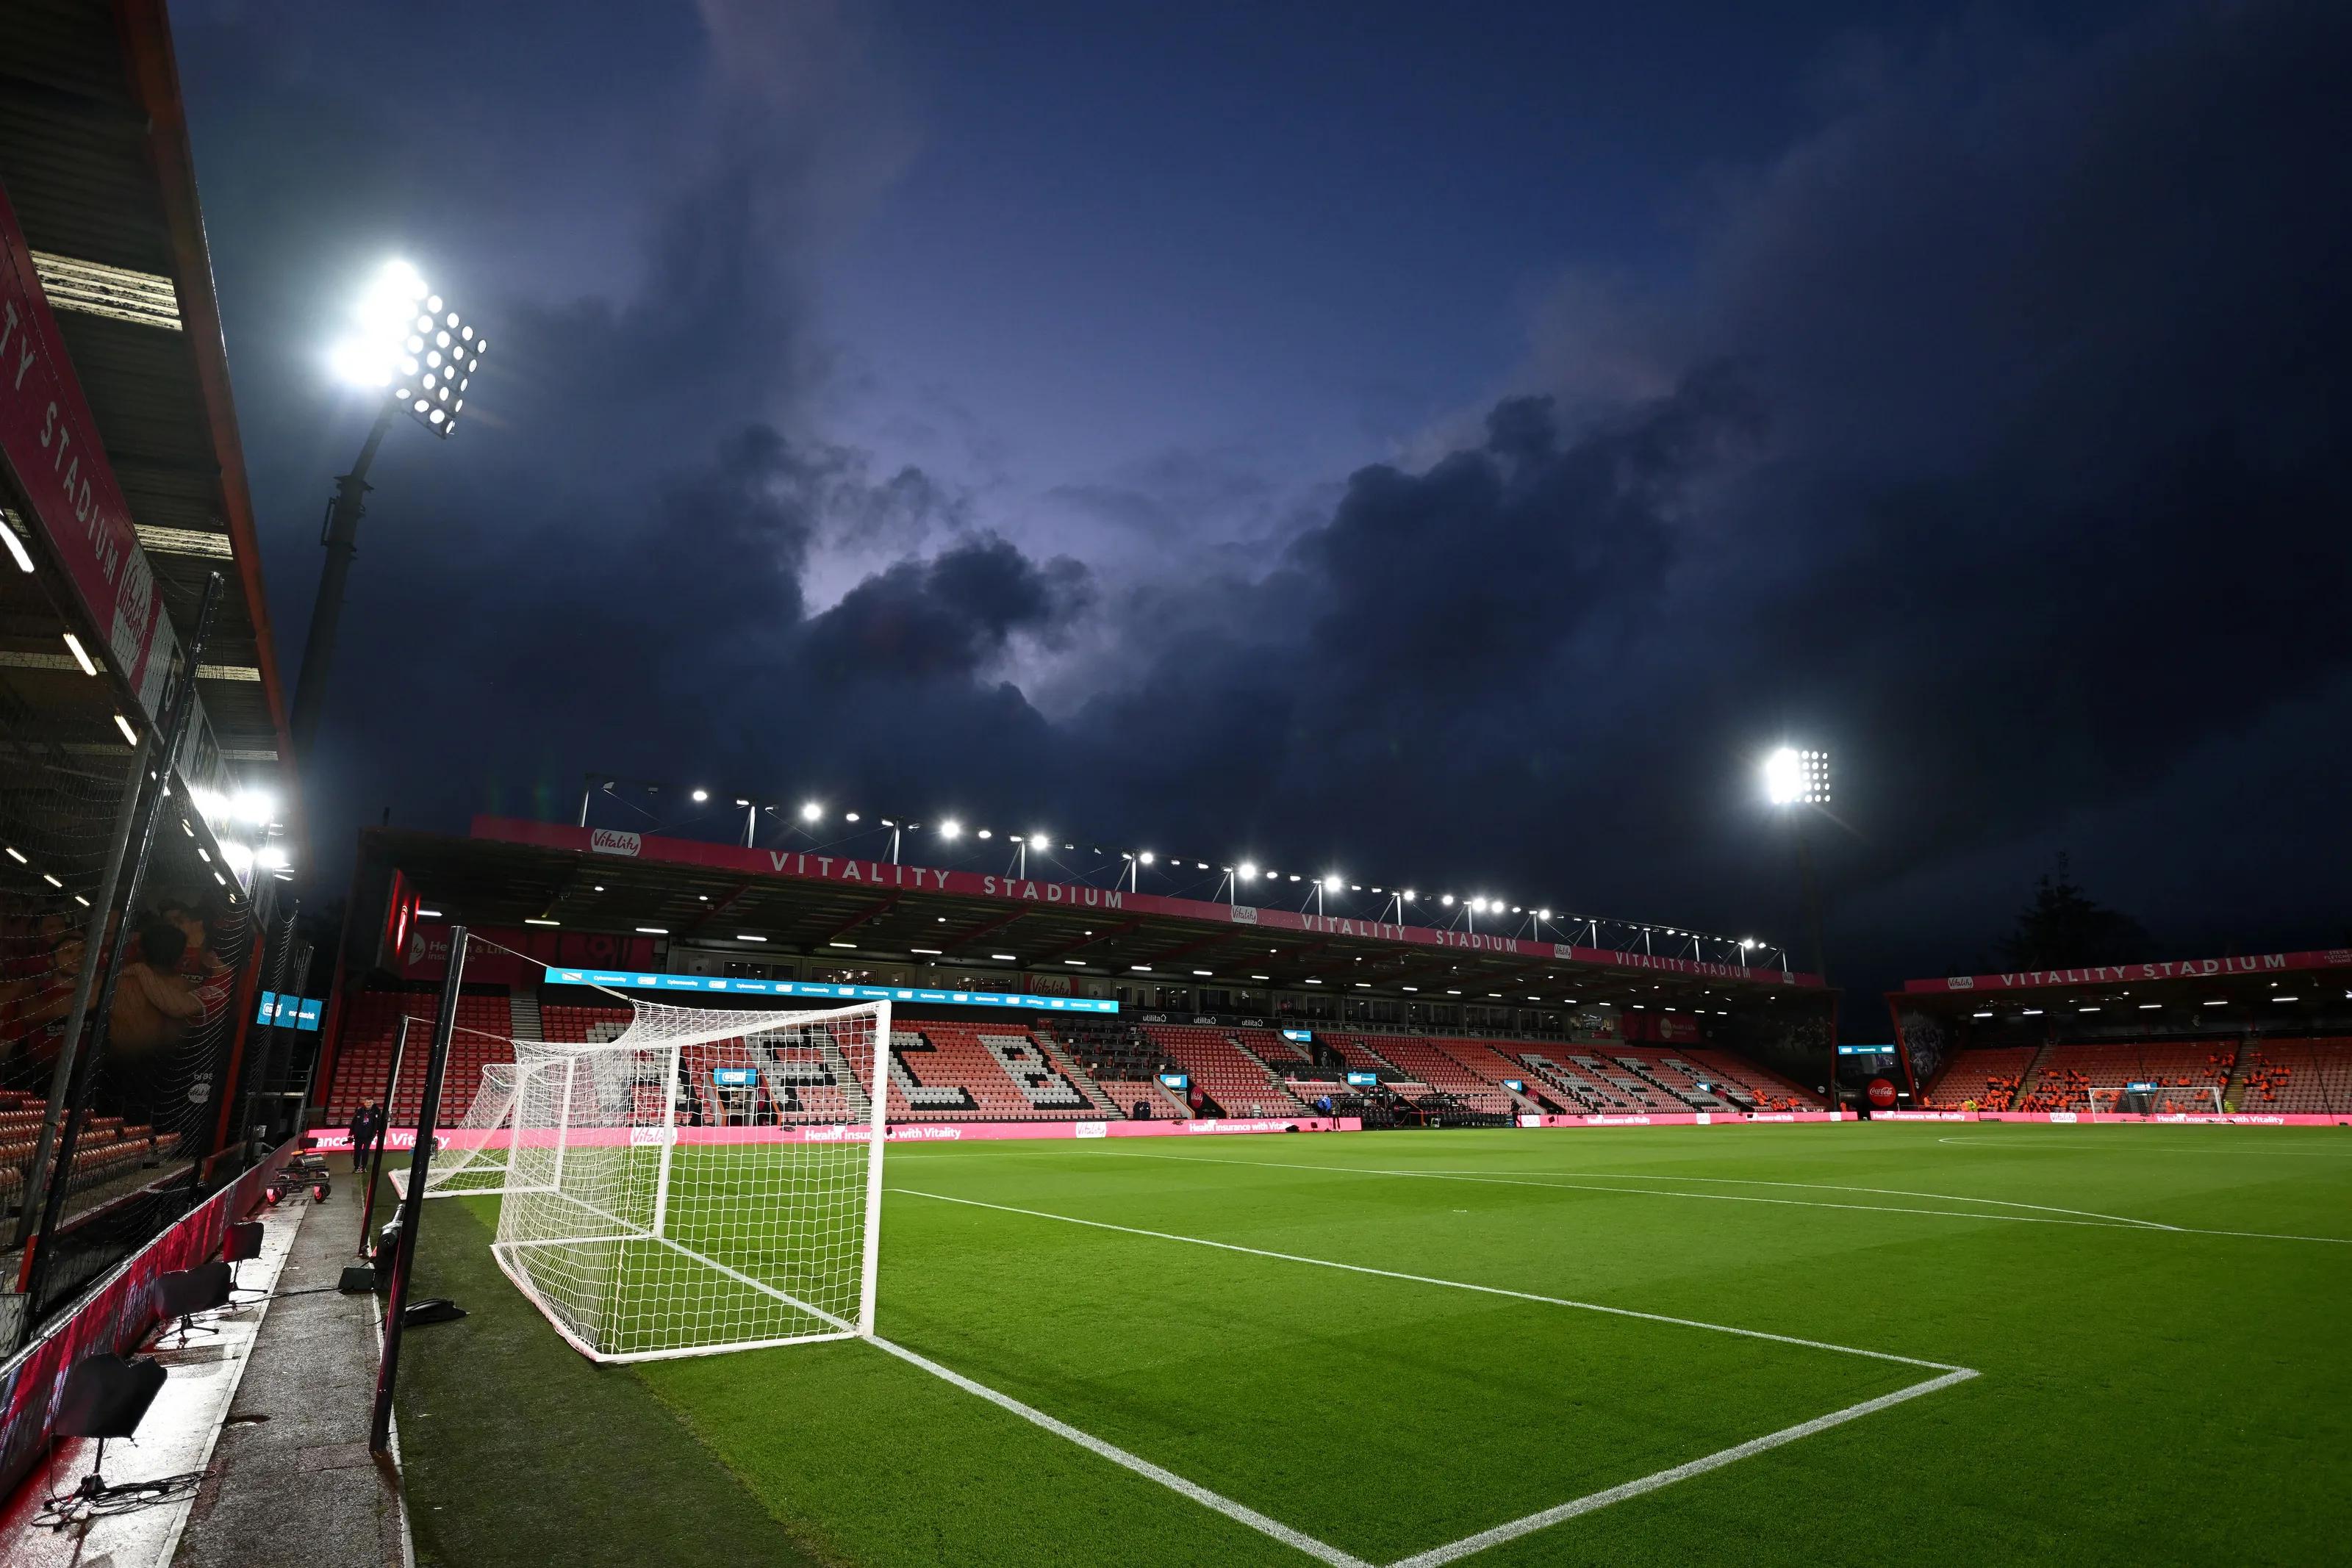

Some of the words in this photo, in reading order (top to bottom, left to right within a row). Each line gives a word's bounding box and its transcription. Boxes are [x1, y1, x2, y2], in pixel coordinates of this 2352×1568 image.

[40, 401, 118, 586] STADIUM
[594, 830, 639, 853] Vitality
[770, 851, 950, 888] VITALITY
[983, 876, 1122, 908] STADIUM
[1233, 907, 1257, 924] Vitality
[1301, 914, 1405, 940] VITALITY
[1435, 930, 1517, 952] STADIUM
[1555, 944, 1571, 958] Vitality
[1616, 952, 1685, 971] VITALITY
[1693, 960, 1752, 979] STADIUM
[2000, 966, 2126, 986] VITALITY
[2143, 954, 2287, 977] STADIUM
[1948, 977, 1973, 988] Vitality
[1142, 1014, 1161, 1022] utilita
[1941, 1112, 1965, 1121] Vitality
[2248, 1115, 2284, 1125] Vitality
[898, 1127, 923, 1139] with
[923, 1126, 961, 1140] Vitality
[1216, 1121, 1250, 1132] insurance
[1252, 1121, 1268, 1130] with
